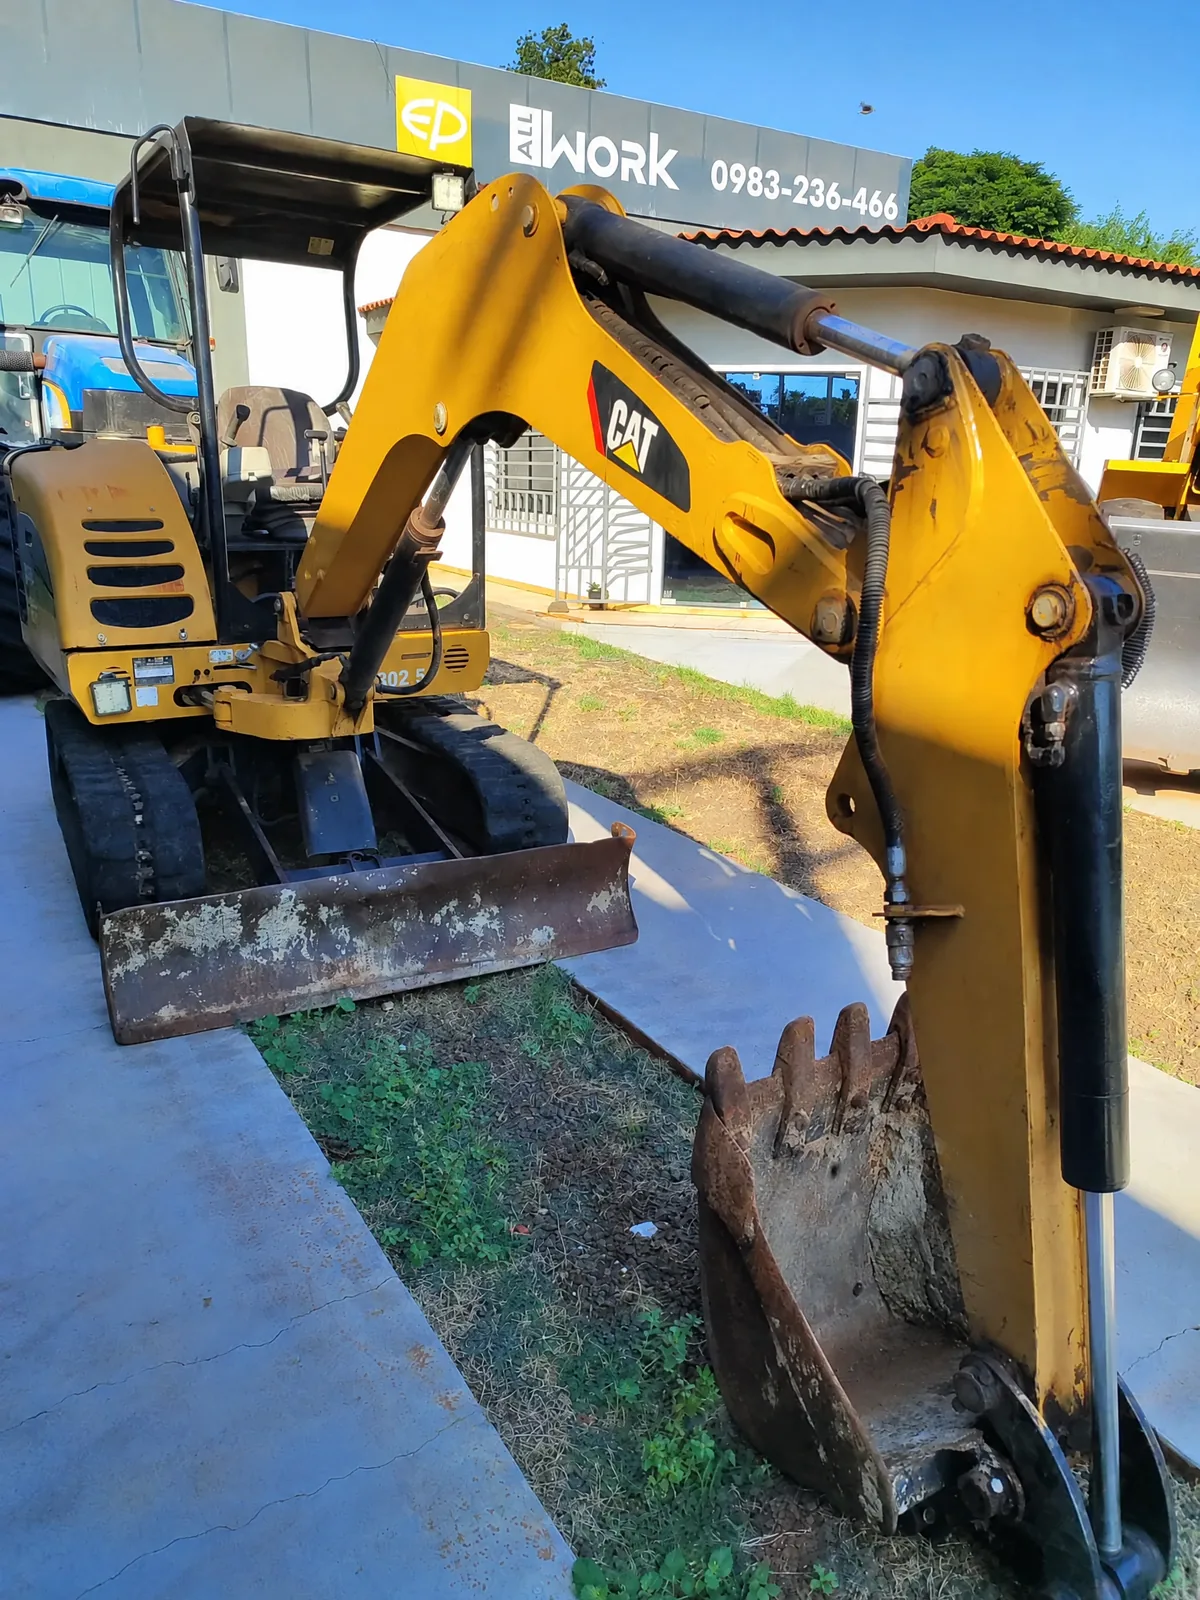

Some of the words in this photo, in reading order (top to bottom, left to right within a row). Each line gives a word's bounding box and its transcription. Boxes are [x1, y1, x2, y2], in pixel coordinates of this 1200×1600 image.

[517, 112, 533, 160] ALL
[542, 109, 680, 191] WORK
[710, 159, 899, 221] 0983-236-466
[607, 399, 659, 474] CAT
